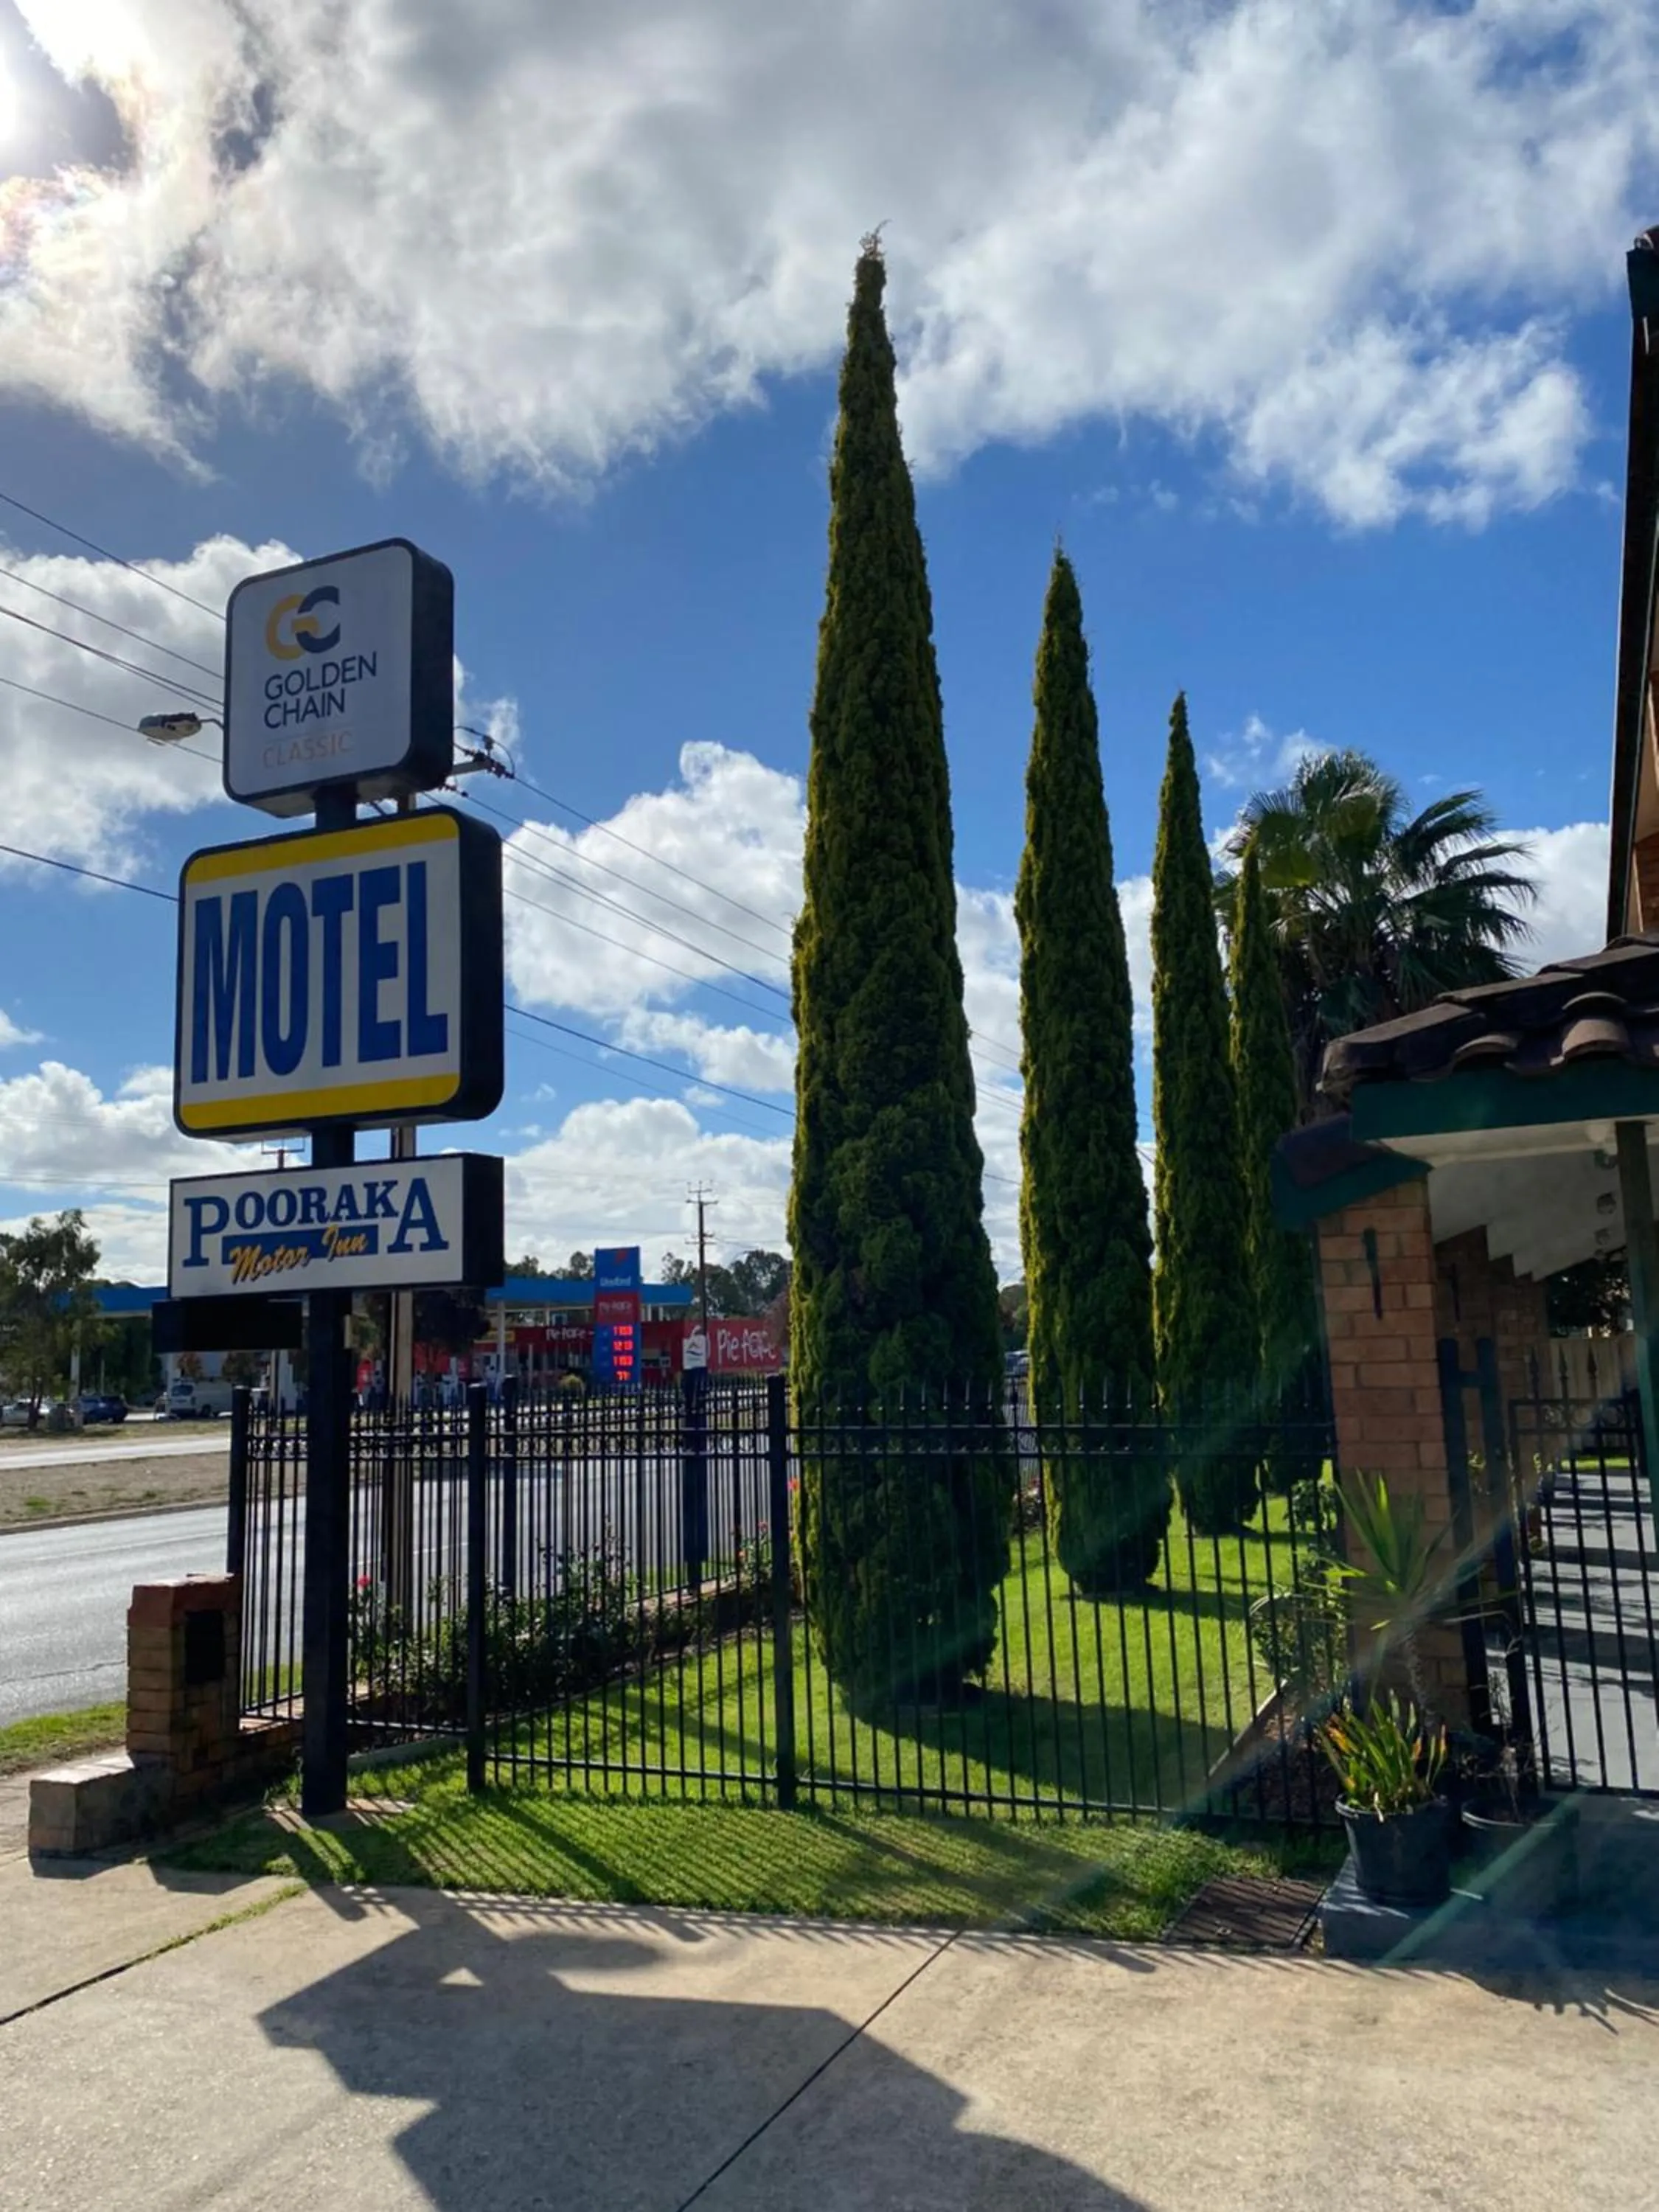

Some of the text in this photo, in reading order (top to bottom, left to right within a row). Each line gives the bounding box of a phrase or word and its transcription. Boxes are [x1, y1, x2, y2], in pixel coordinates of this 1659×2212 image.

[264, 651, 378, 700] GOLDEN
[264, 688, 346, 729] CHAIN
[262, 731, 355, 769] CLASSIC
[191, 860, 448, 1085] MOTEL
[182, 1177, 449, 1267] POORAKA
[229, 1224, 368, 1284] Motor Inn
[717, 1329, 741, 1366] Pie
